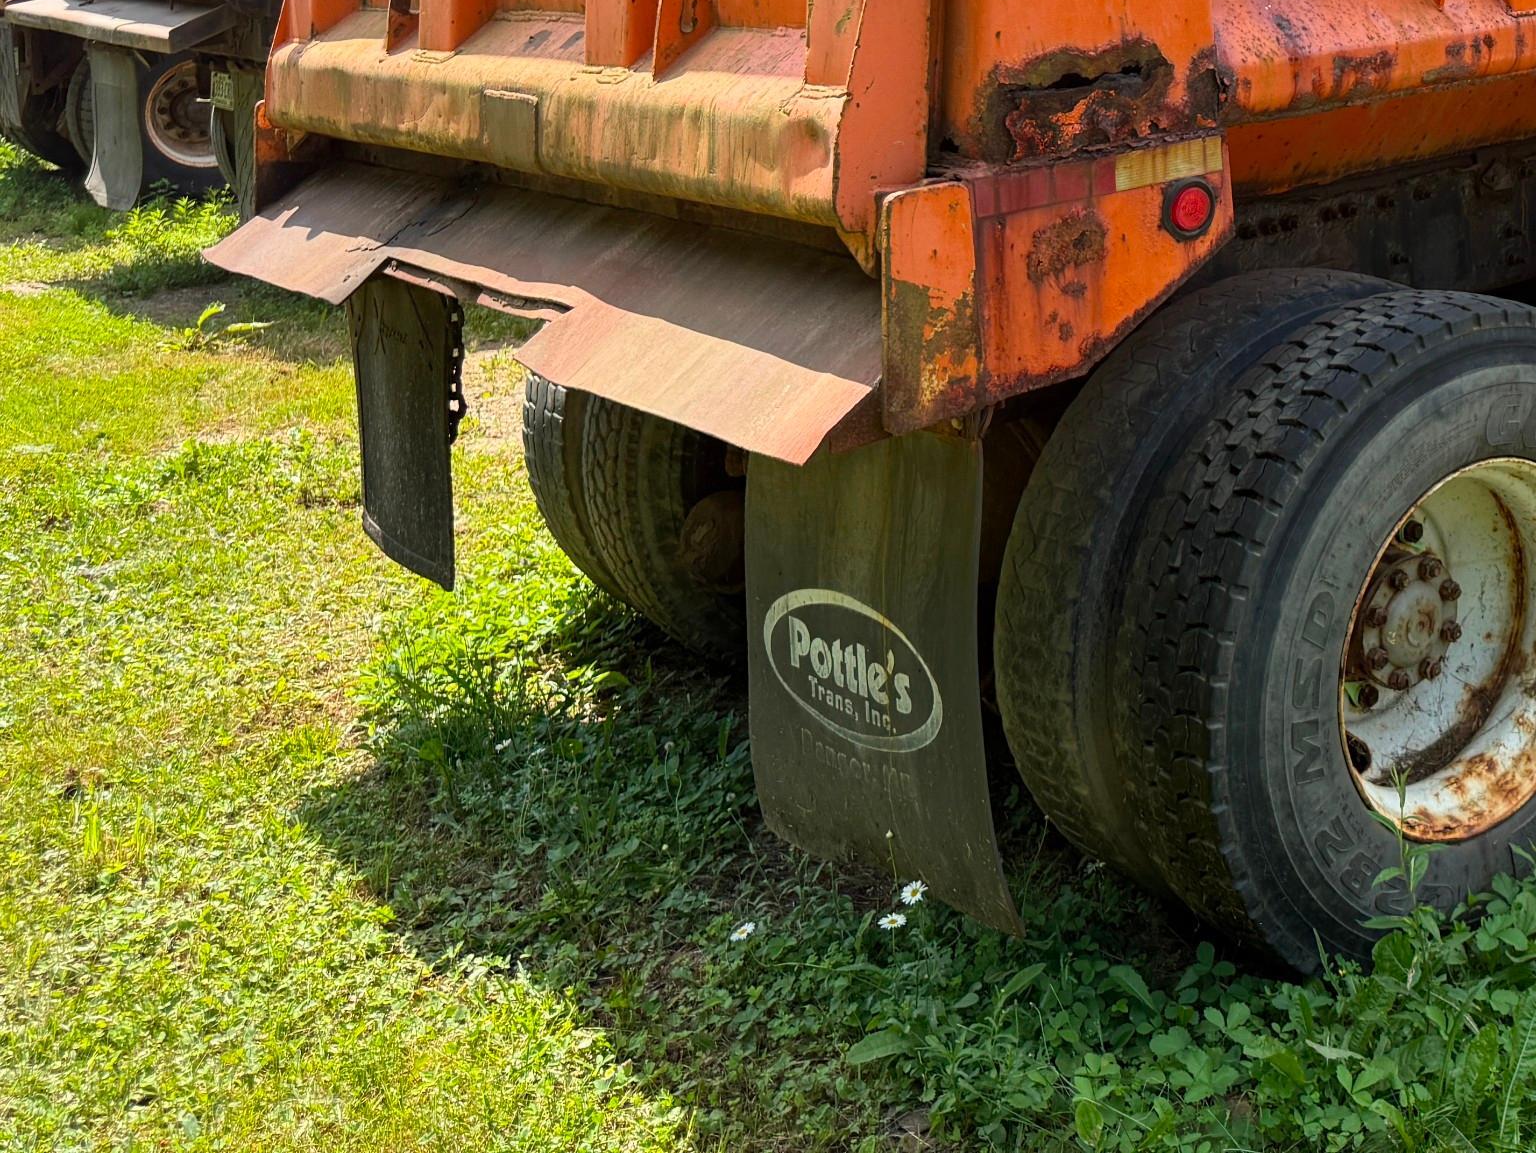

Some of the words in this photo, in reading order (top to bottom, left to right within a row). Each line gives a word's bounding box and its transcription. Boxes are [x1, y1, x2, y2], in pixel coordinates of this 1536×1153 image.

[788, 615, 913, 715] Pottle's
[808, 675, 859, 721] Trans,
[1290, 591, 1336, 786] MSD
